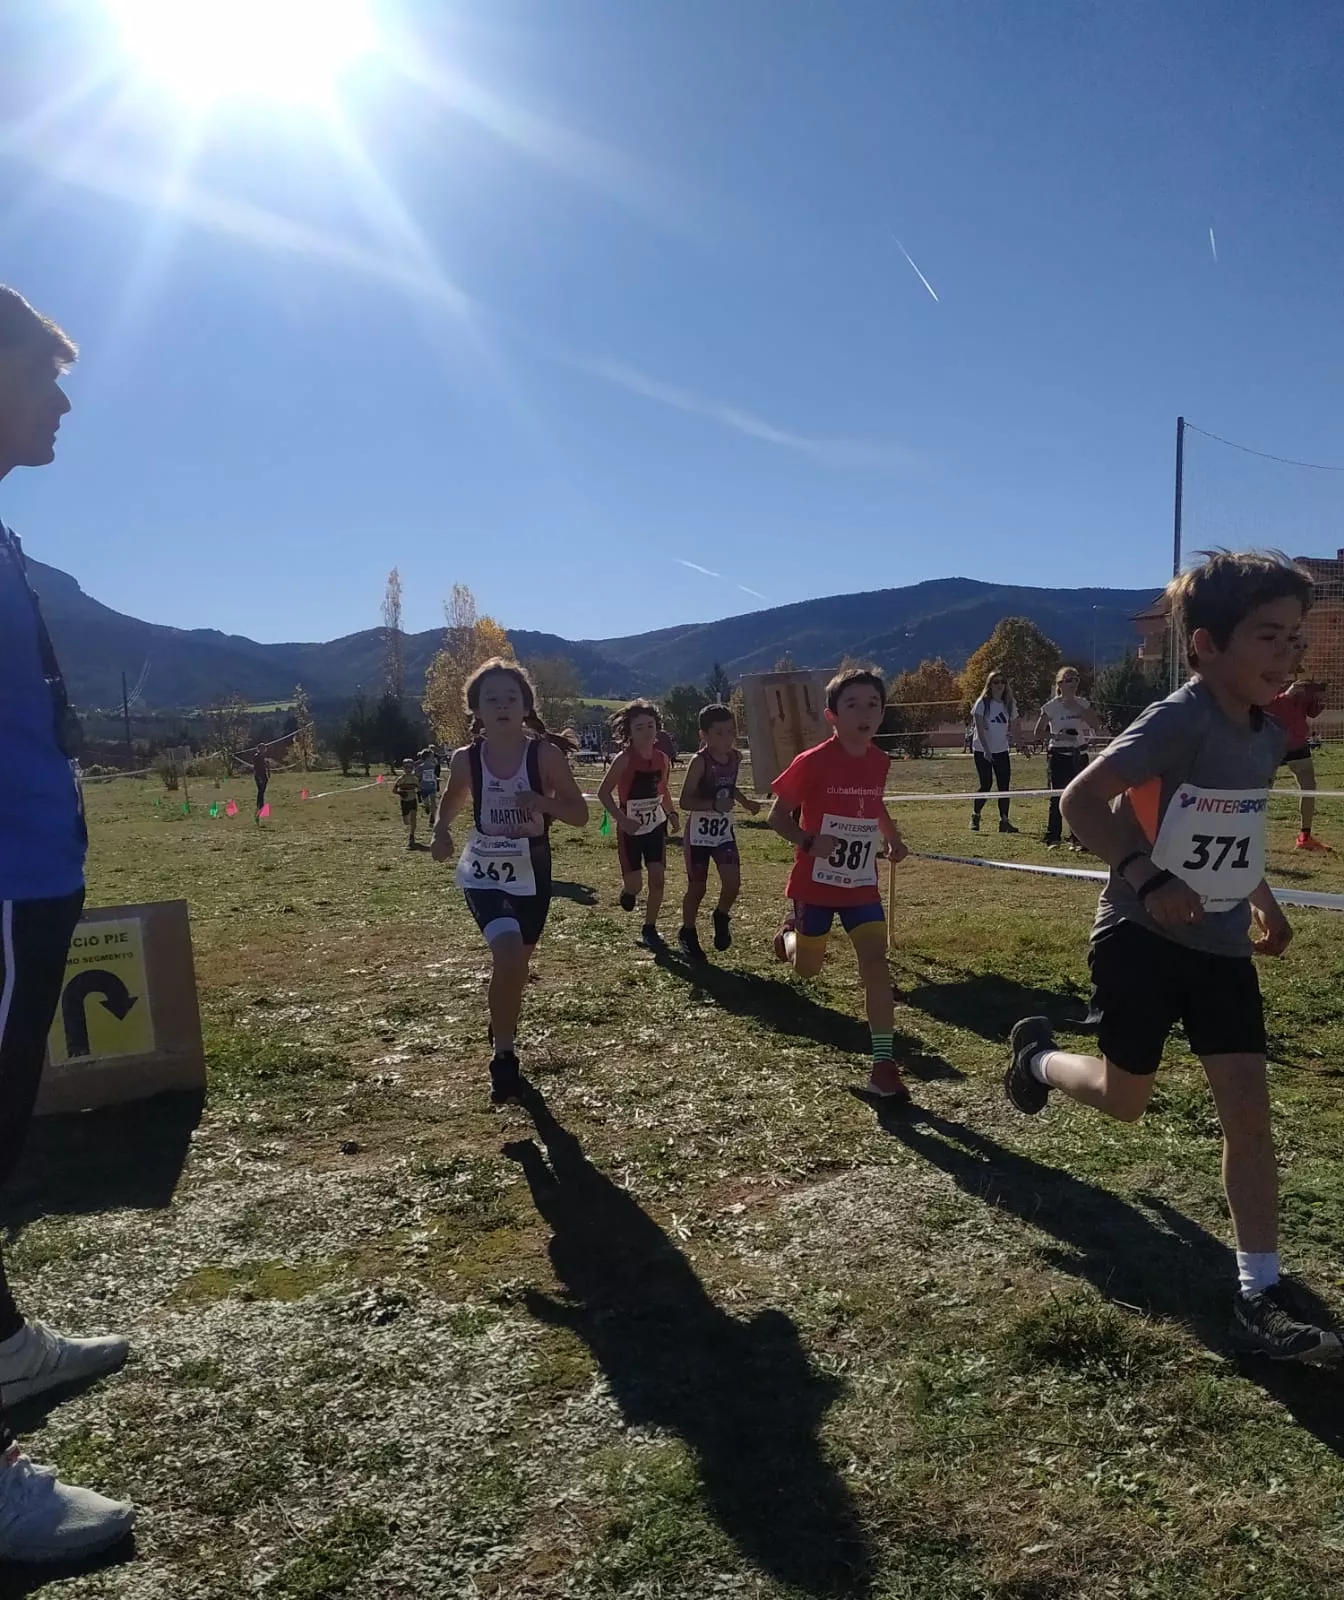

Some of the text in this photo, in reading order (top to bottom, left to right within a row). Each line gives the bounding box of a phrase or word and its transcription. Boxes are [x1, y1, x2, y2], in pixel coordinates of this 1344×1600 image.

[490, 808, 534, 825] MARTINA
[698, 817, 729, 837] 382
[828, 838, 872, 871] 381
[1182, 834, 1251, 872] 371
[472, 860, 517, 883] 362
[71, 932, 129, 948] CIO PIE
[82, 951, 134, 963] SEGMENTO
